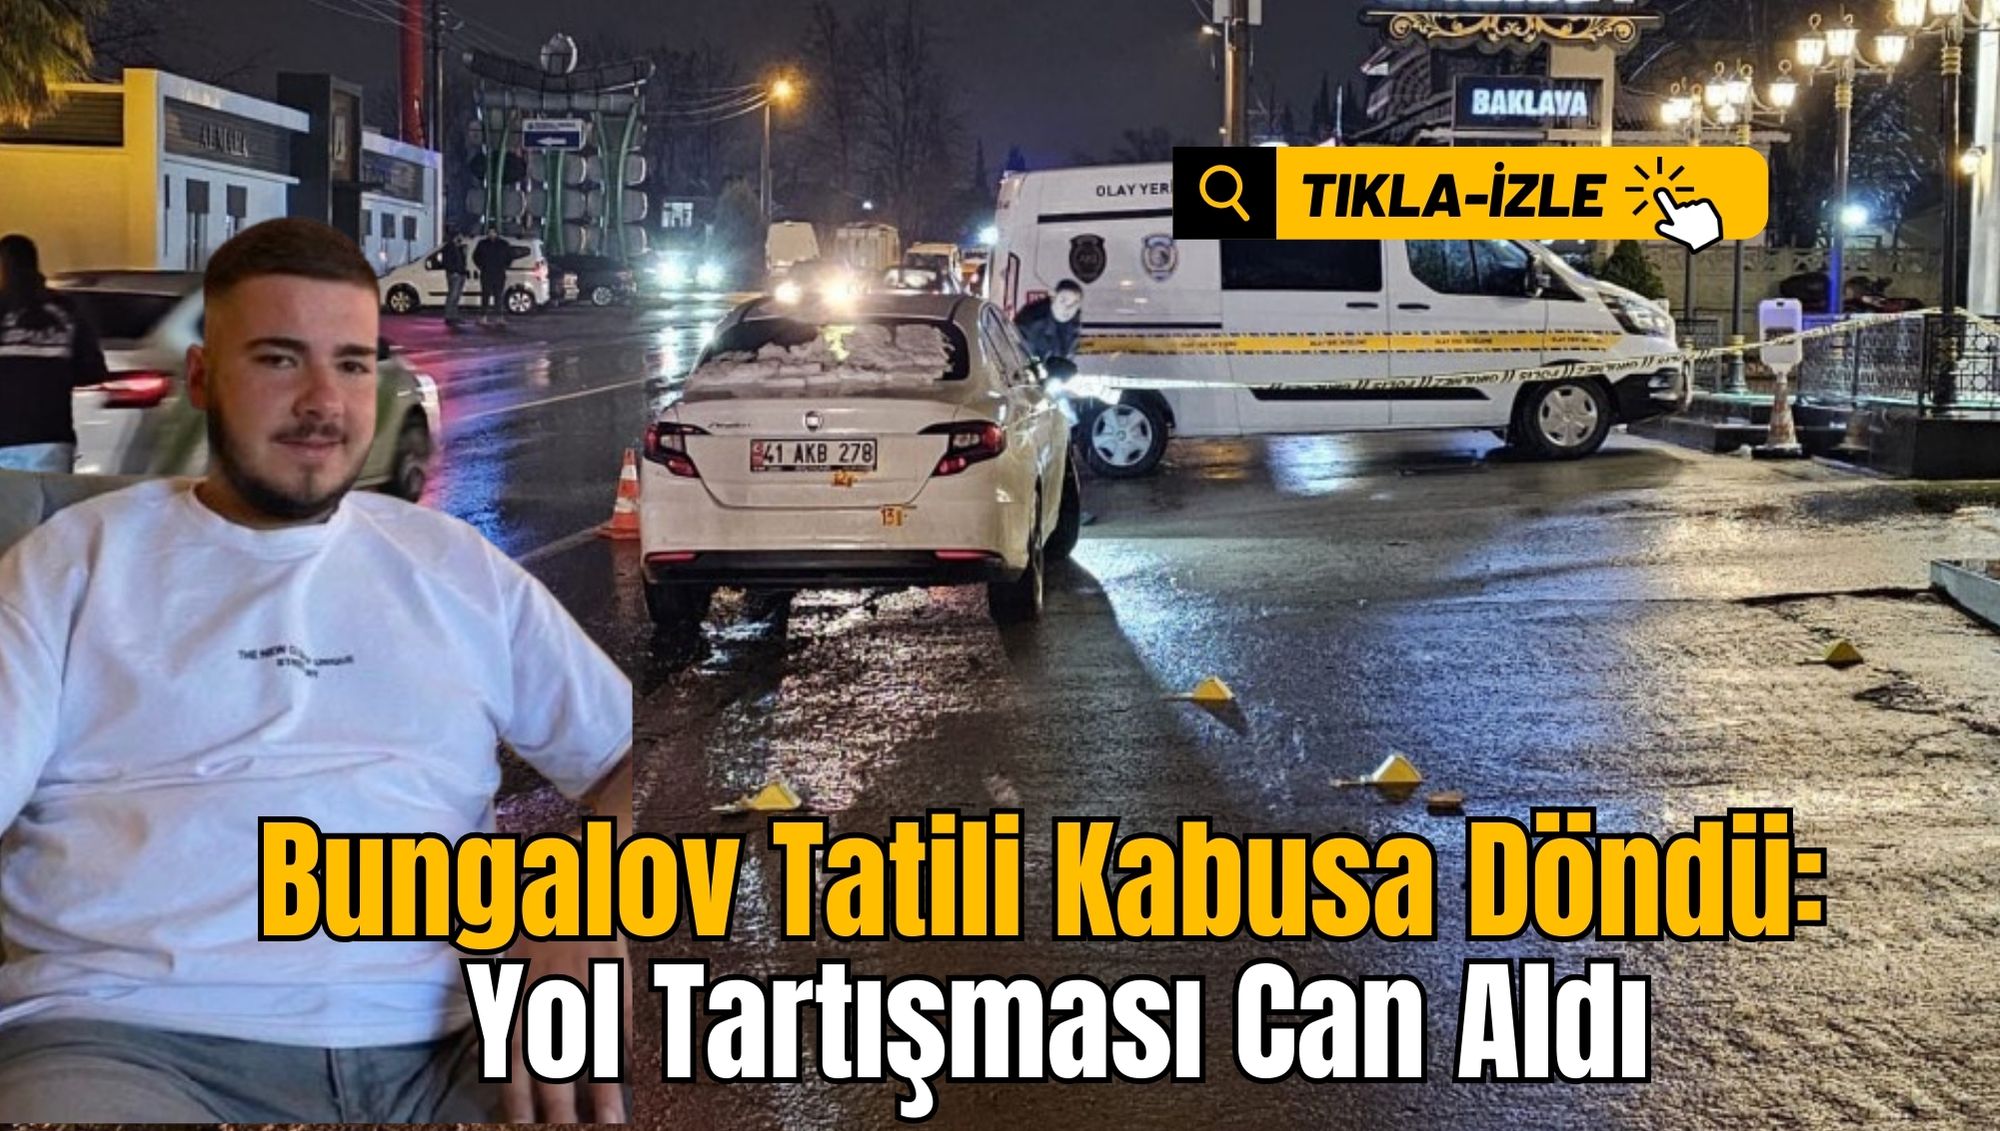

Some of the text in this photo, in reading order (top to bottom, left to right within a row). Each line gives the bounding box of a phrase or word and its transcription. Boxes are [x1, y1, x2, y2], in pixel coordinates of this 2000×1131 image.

[1471, 88, 1588, 117] BAKLAVA
[1095, 183, 1135, 197] OLAY
[763, 443, 874, 463] 41 AKB 278
